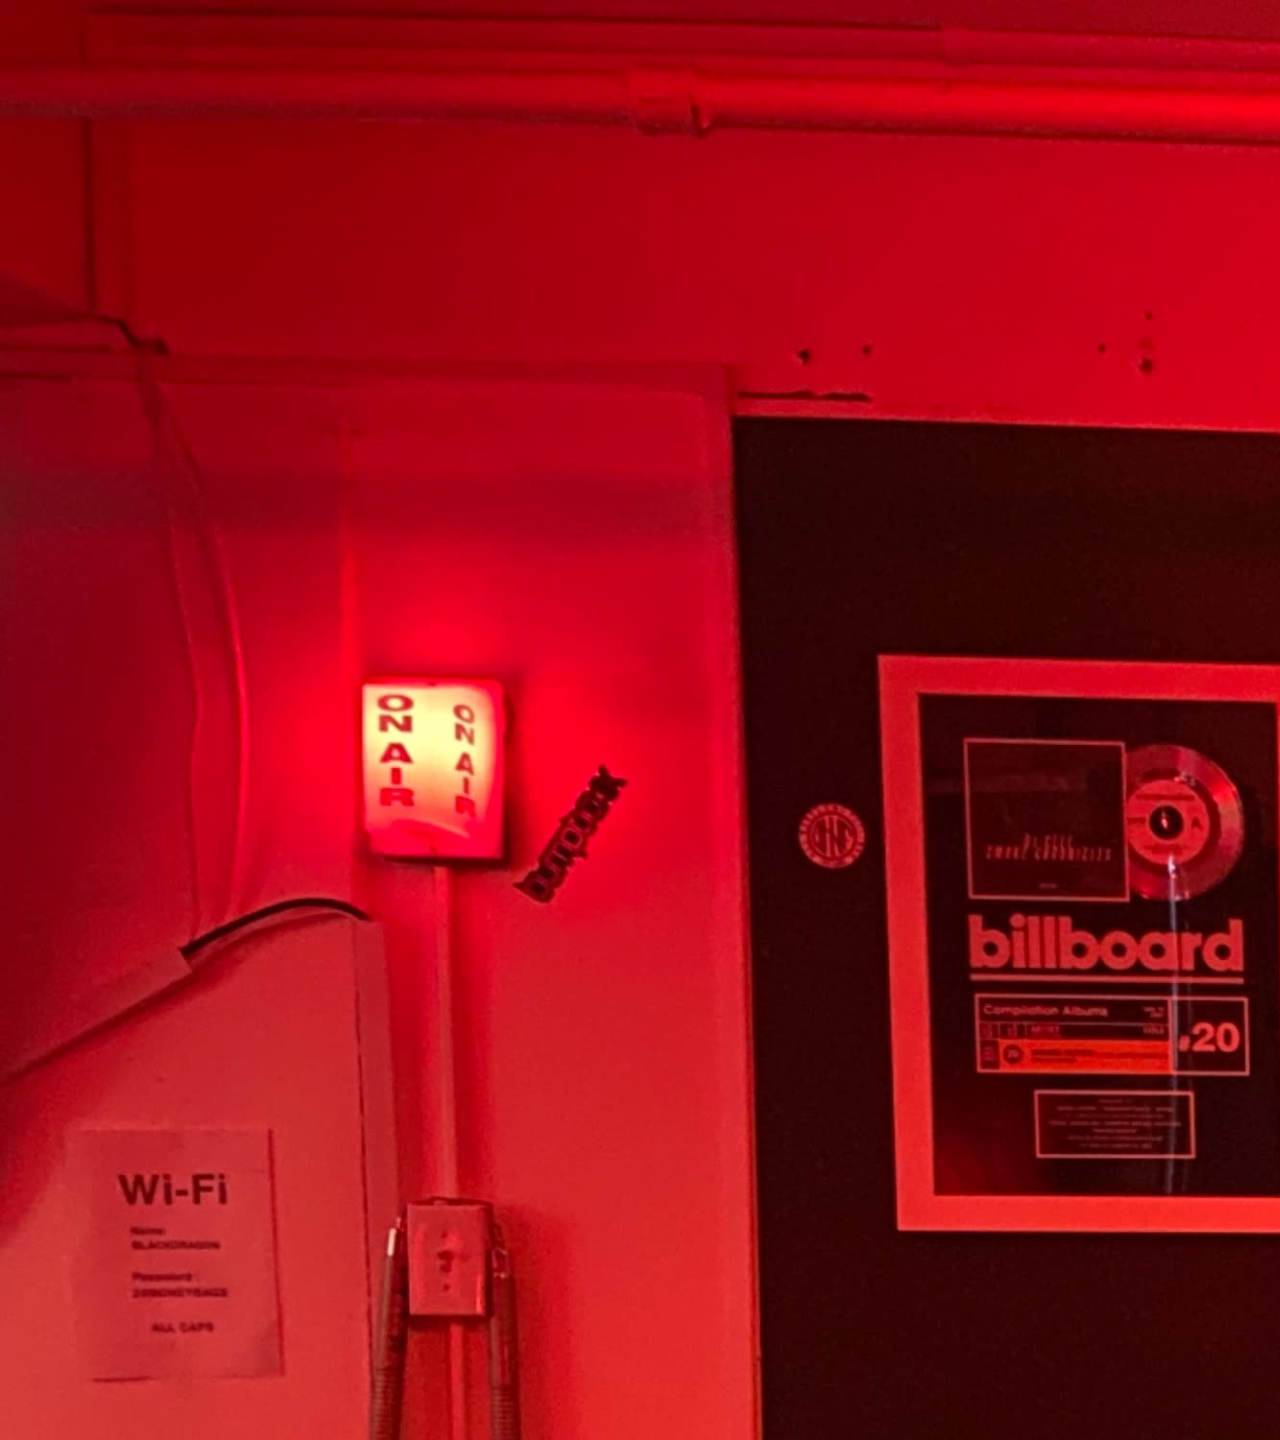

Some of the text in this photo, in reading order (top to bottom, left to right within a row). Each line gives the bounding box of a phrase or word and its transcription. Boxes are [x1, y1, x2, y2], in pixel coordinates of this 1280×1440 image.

[377, 694, 415, 807] ON AIR
[453, 704, 476, 818] ON AIR
[968, 913, 1244, 972] billboard
[983, 1003, 1108, 1017] Compilation Albums
[118, 1173, 228, 1206] Wi-Fi
